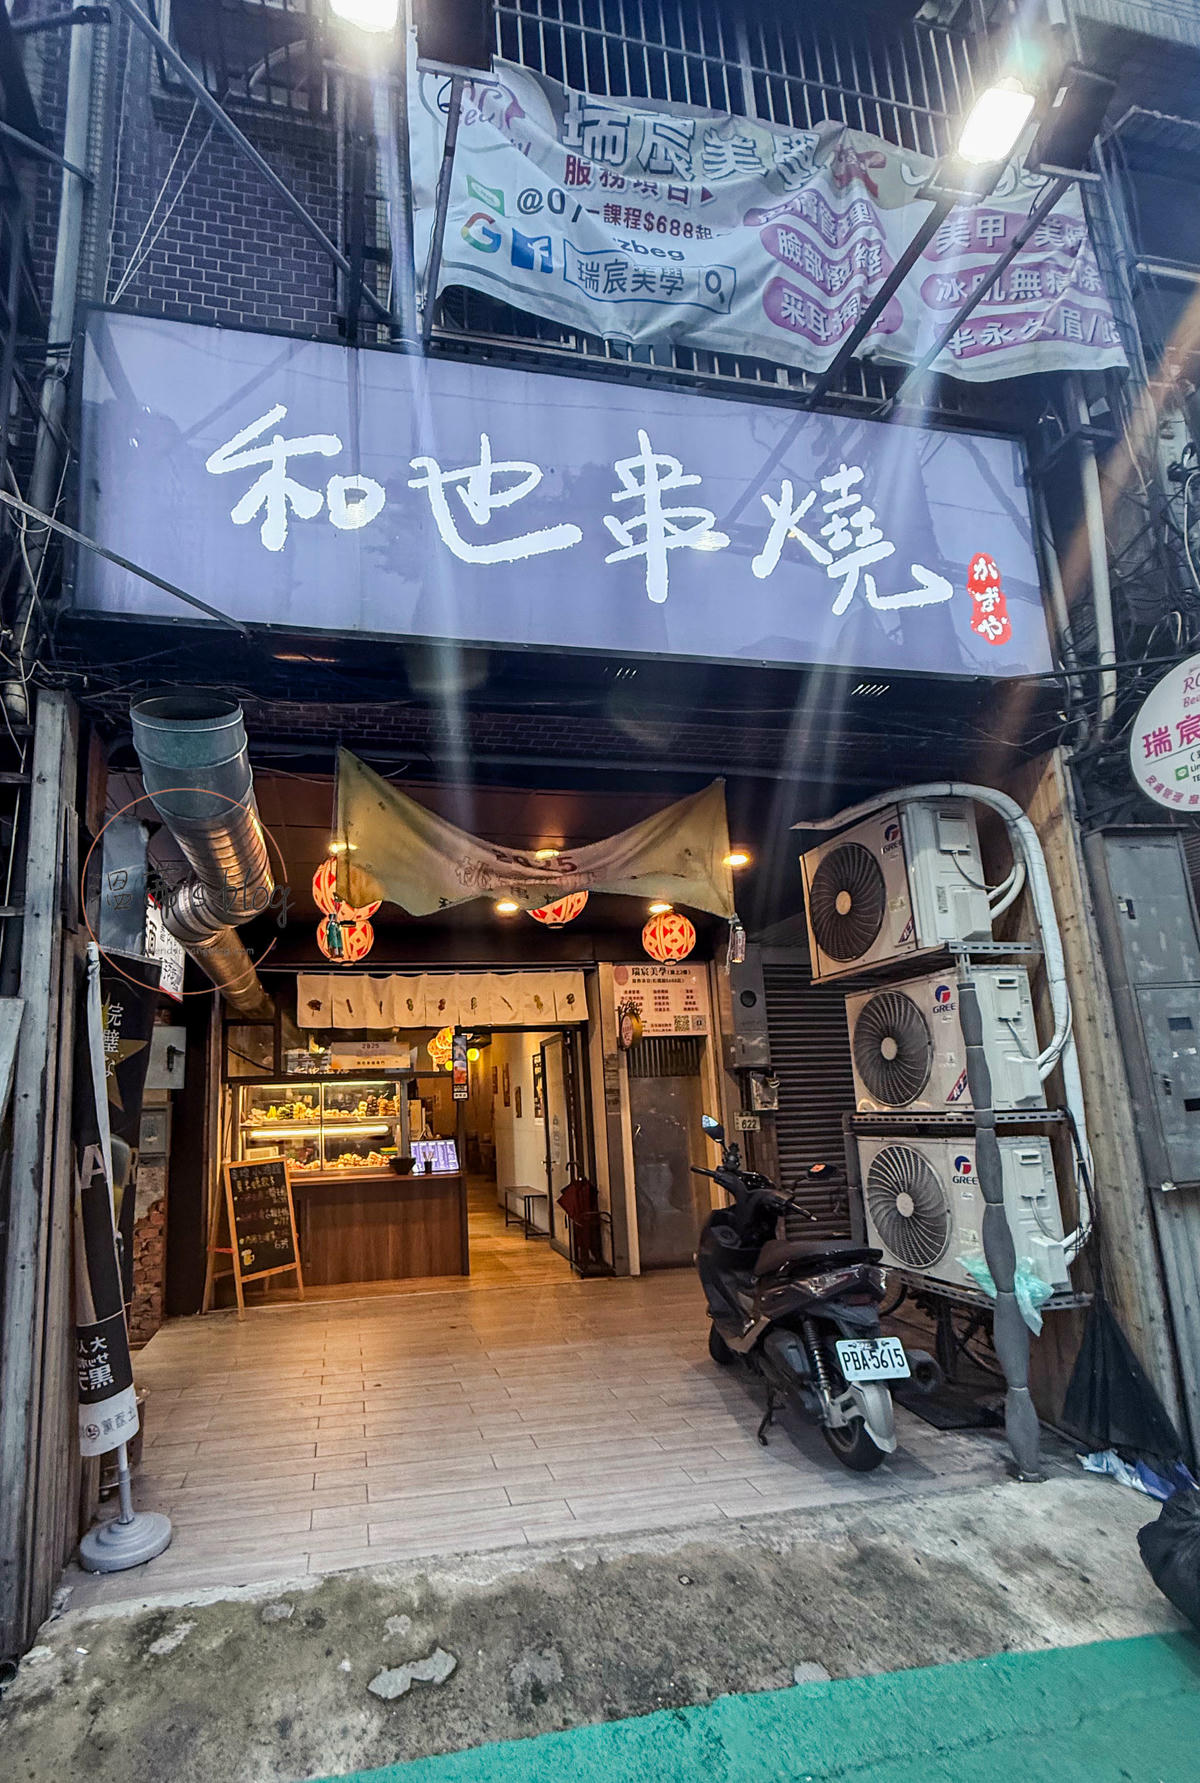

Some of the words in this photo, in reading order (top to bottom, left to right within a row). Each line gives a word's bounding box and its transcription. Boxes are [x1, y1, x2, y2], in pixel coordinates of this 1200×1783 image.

[206, 403, 953, 617] 和也串燒
[932, 1002, 957, 1014] GREE
[741, 1119, 757, 1129] 622
[952, 1175, 979, 1185] GREE
